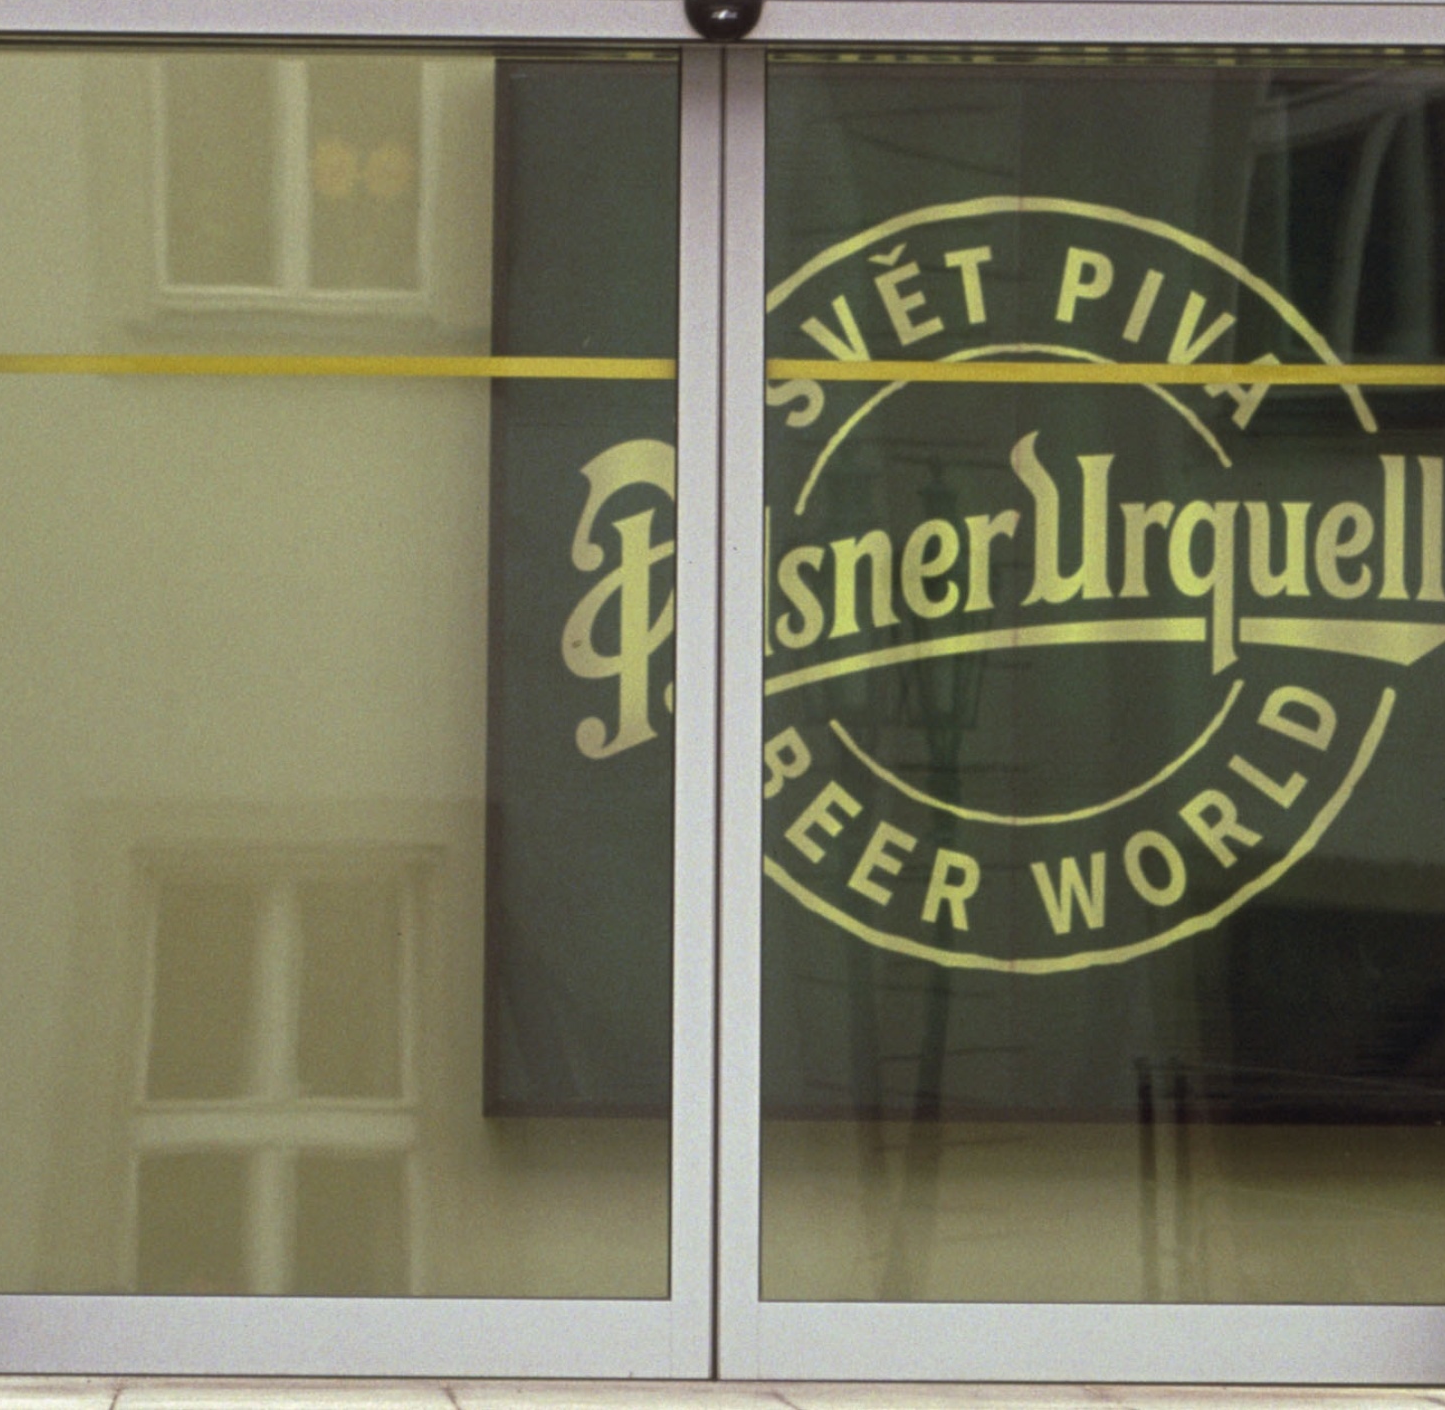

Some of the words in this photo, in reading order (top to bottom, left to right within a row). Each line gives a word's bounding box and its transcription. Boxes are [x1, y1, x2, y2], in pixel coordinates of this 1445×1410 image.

[1055, 246, 1281, 431] PIVA
[563, 439, 1019, 758] Psner
[763, 727, 981, 931] BEER
[1032, 686, 1337, 935] WORLD
